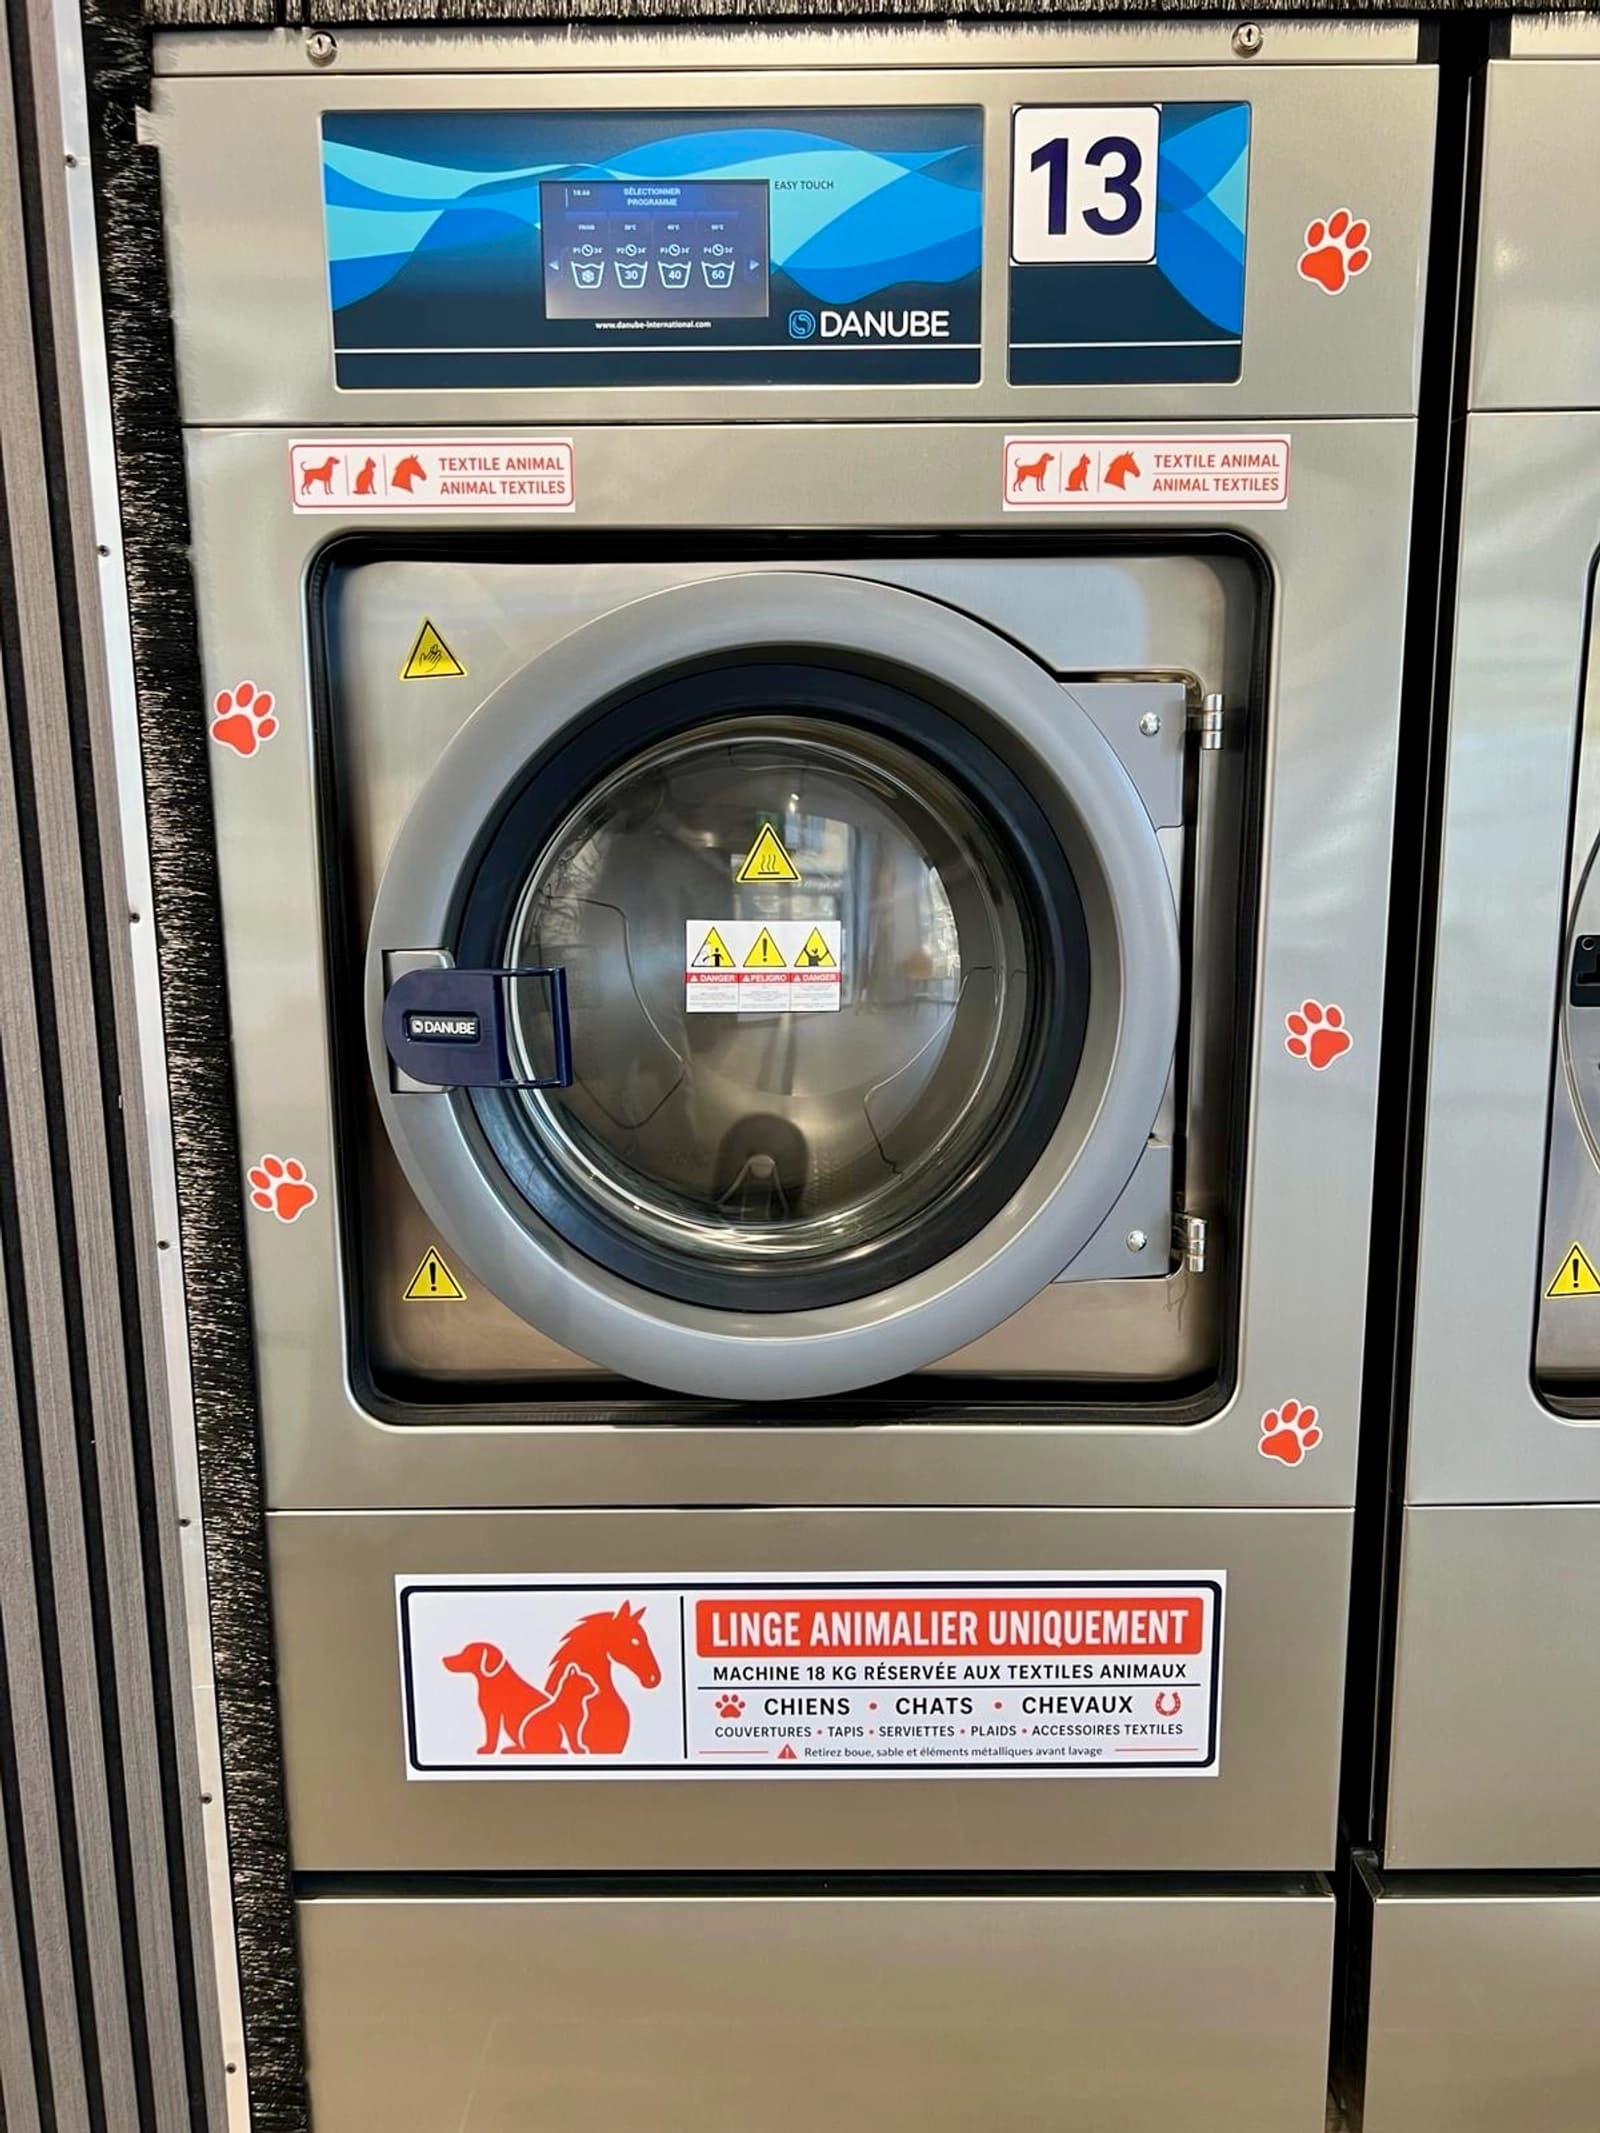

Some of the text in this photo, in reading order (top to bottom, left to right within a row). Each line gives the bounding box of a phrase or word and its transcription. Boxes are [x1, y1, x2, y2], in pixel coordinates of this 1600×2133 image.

[624, 187, 681, 196] SÉLECTIONNER
[774, 181, 834, 190] EASY TOUCH
[1030, 136, 1142, 236] 13
[627, 198, 678, 206] PROGRAMME
[625, 270, 638, 280] 30
[669, 270, 682, 280] 40
[712, 270, 725, 280] 60
[595, 320, 712, 330] www.danube-international.com
[820, 310, 950, 337] DANUBE
[438, 457, 564, 471] TEXTILE ANIMAL
[1154, 454, 1280, 468] TEXTILE ANIMAL
[440, 480, 565, 495] ANIMAL TEXTILES
[1153, 478, 1279, 492] ANIMAL TEXTILES
[803, 974, 836, 982] DANGER
[424, 1021, 476, 1035] DANUBE
[712, 1609, 1189, 1648] LINGE ANIMALIER UNIQUEMENT
[713, 1662, 1187, 1681] MACHINE 18 KG RÉSERVÉE AUX TEXTILES ANIMAUX
[764, 1696, 1133, 1715] CHIENS CHATS CHEVAUX
[715, 1724, 1183, 1738] COUVERTURES TAPIS SERVIETTES PLAIDS ACCESSOIRES TEXTILES
[804, 1746, 1103, 1758] Retirez boue, sable et éléments métalliques avant lavage
